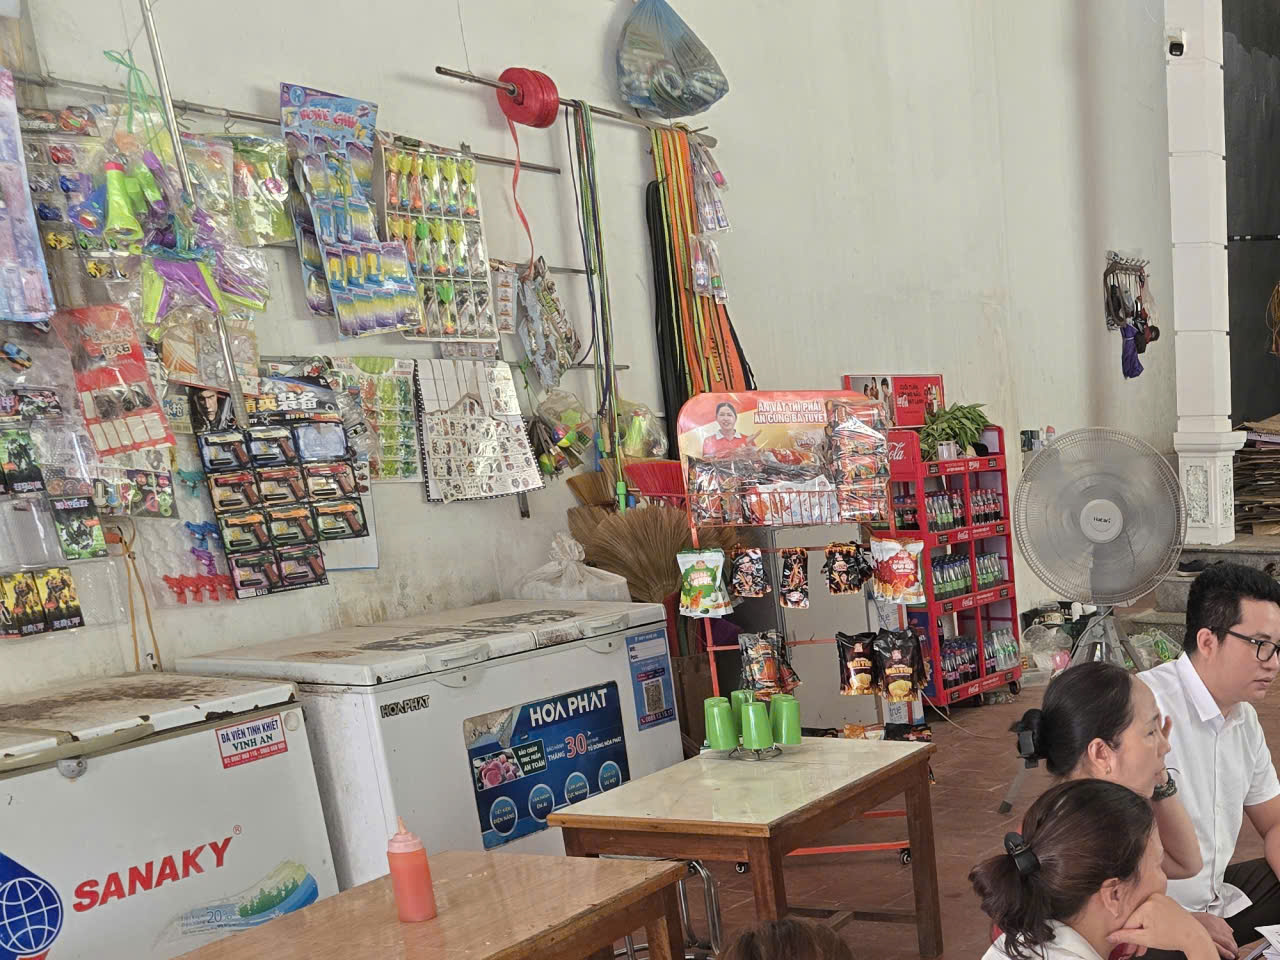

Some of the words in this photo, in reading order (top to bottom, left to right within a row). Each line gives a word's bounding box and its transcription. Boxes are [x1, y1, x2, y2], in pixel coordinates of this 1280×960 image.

[529, 701, 567, 727] HÒA
[567, 688, 608, 717] PHÁT
[260, 733, 274, 746] AN
[564, 732, 588, 760] 30
[73, 836, 232, 912] SANAKY
